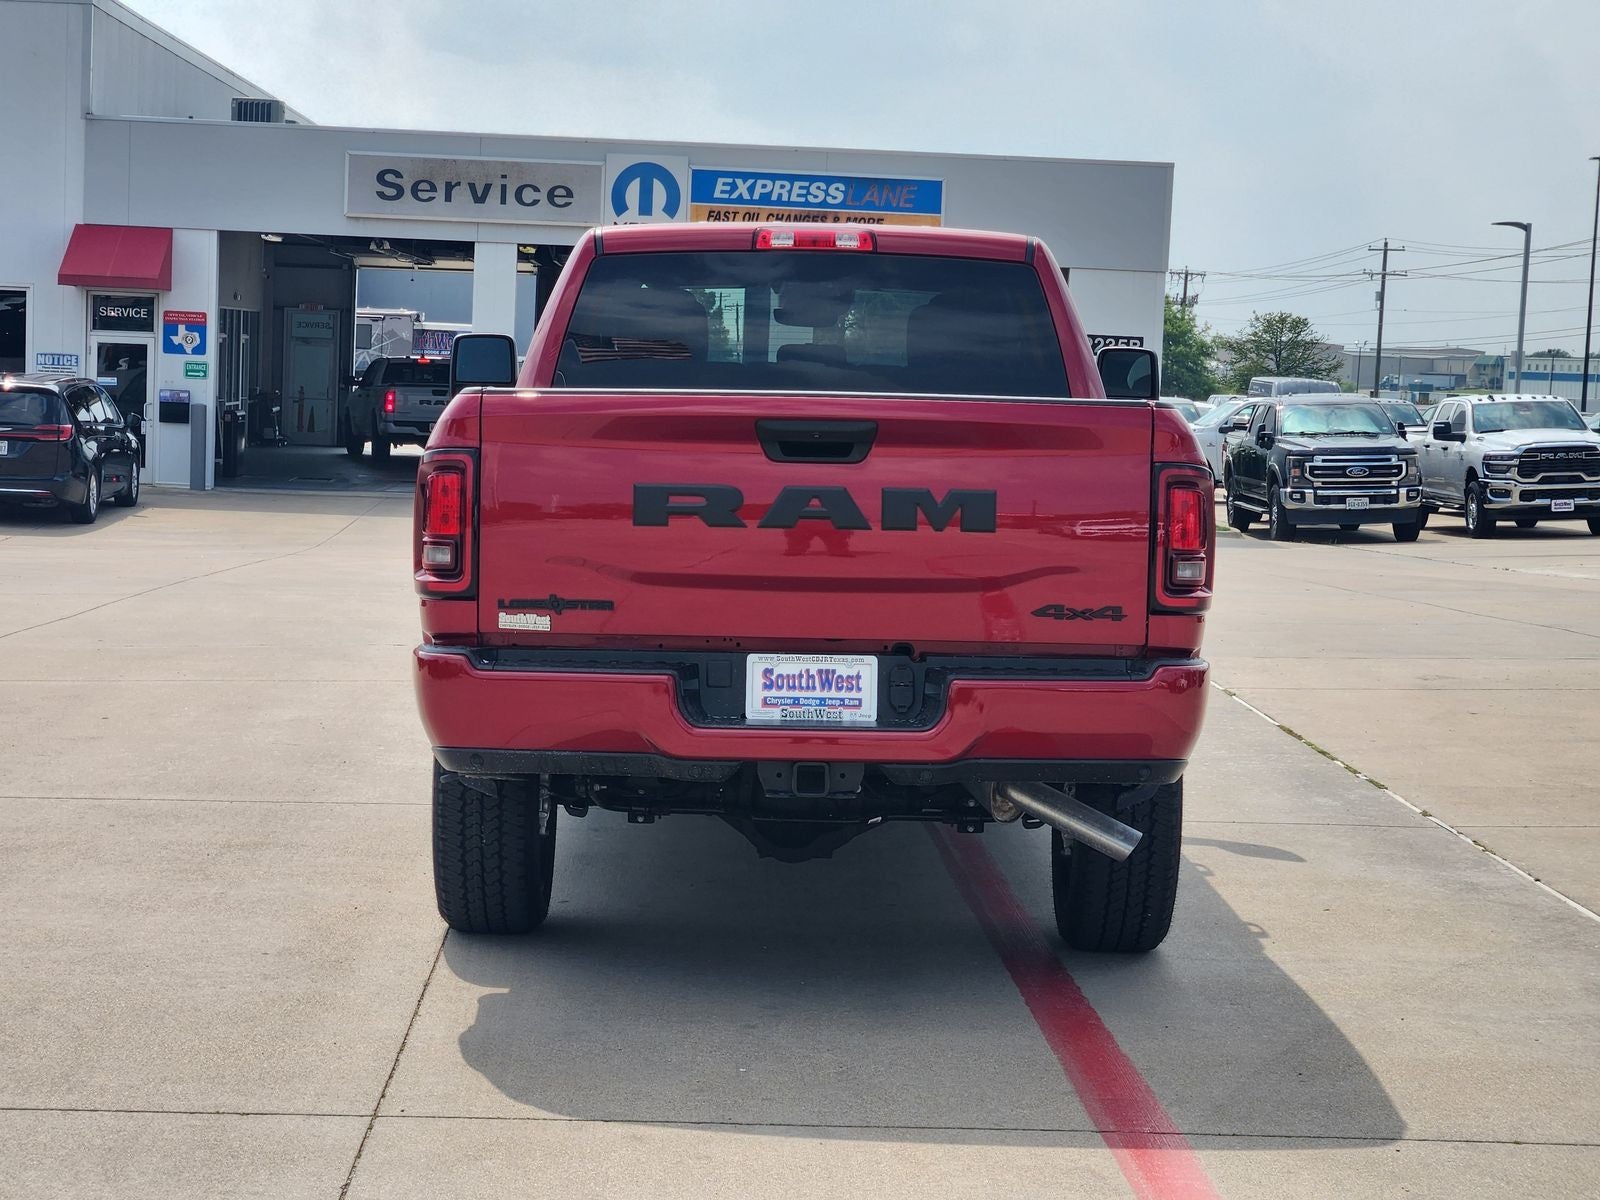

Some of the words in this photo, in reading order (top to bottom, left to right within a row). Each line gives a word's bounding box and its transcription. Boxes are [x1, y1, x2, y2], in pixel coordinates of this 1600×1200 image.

[376, 169, 574, 208] Service
[707, 210, 740, 222] FAST
[99, 306, 148, 318] SERVICE
[37, 354, 78, 365] NOTICE
[187, 363, 206, 371] ENTRANCE
[633, 484, 997, 533] RAM
[1031, 604, 1128, 622] 4x4
[761, 667, 863, 693] SouthWest
[766, 698, 794, 706] Chrysler
[799, 699, 820, 707] Dodge
[781, 709, 843, 719] SouthWest
